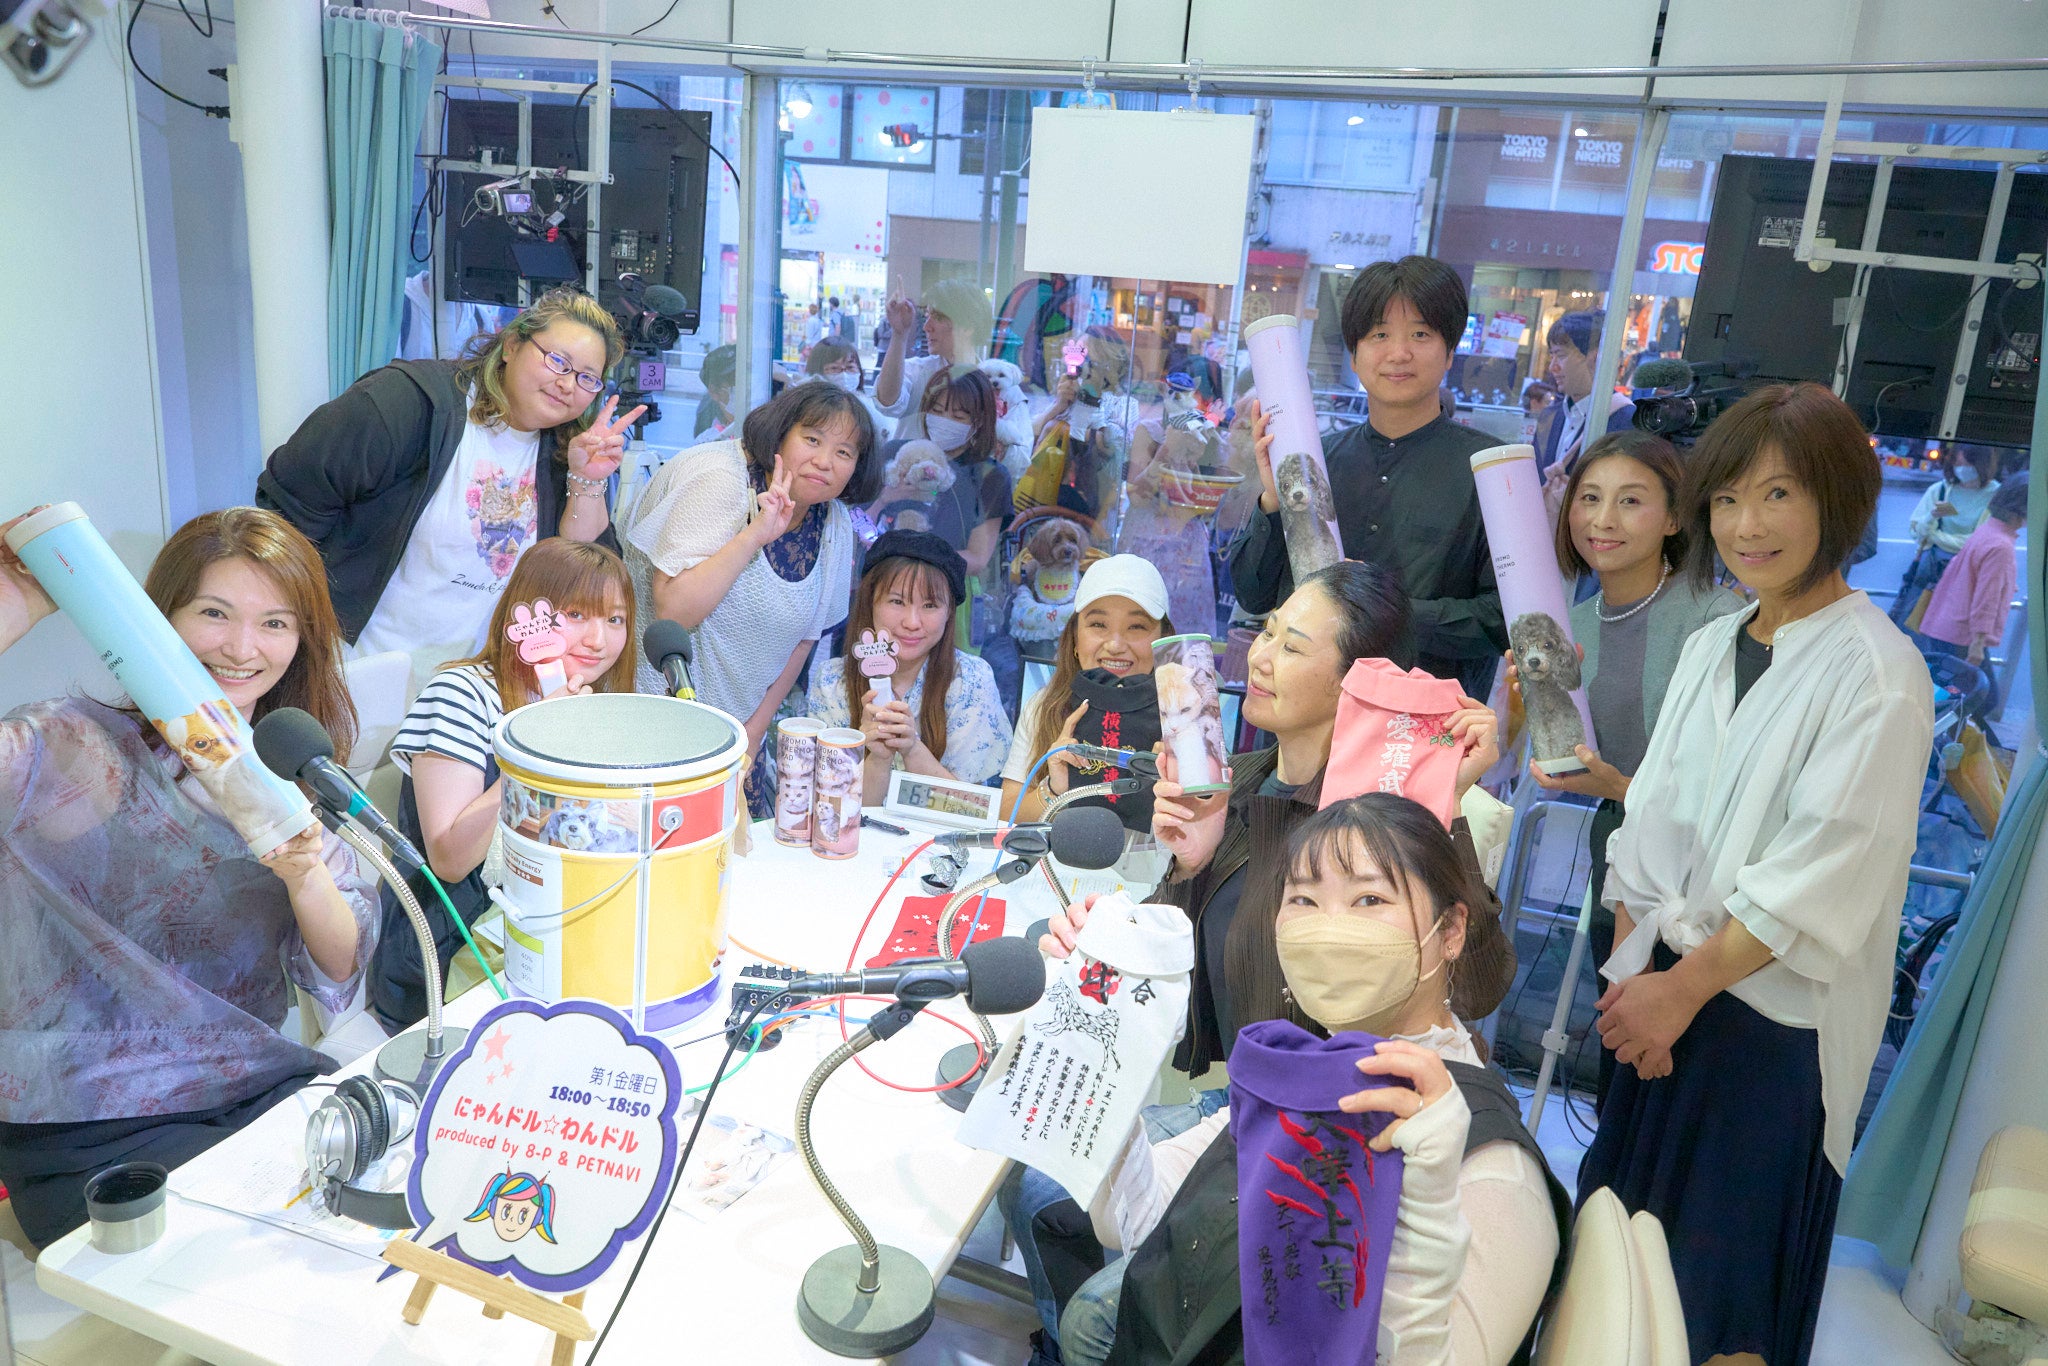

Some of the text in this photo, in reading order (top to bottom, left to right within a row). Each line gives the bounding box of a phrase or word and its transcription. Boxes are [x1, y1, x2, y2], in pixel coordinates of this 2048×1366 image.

[1503, 134, 1548, 147] TOKYO
[1577, 139, 1623, 153] TOKYO
[1501, 145, 1547, 159] NIGHTS
[1575, 150, 1621, 164] NIGHTS
[648, 365, 656, 377] 3
[642, 378, 662, 387] CAM
[781, 734, 807, 746] PROMO
[780, 744, 812, 755] THERMO
[521, 860, 542, 874] Energy
[1130, 978, 1156, 1006] 合
[589, 1066, 658, 1095] 第1金曜日
[435, 1125, 642, 1183] produced by 8-P & PETNAVI
